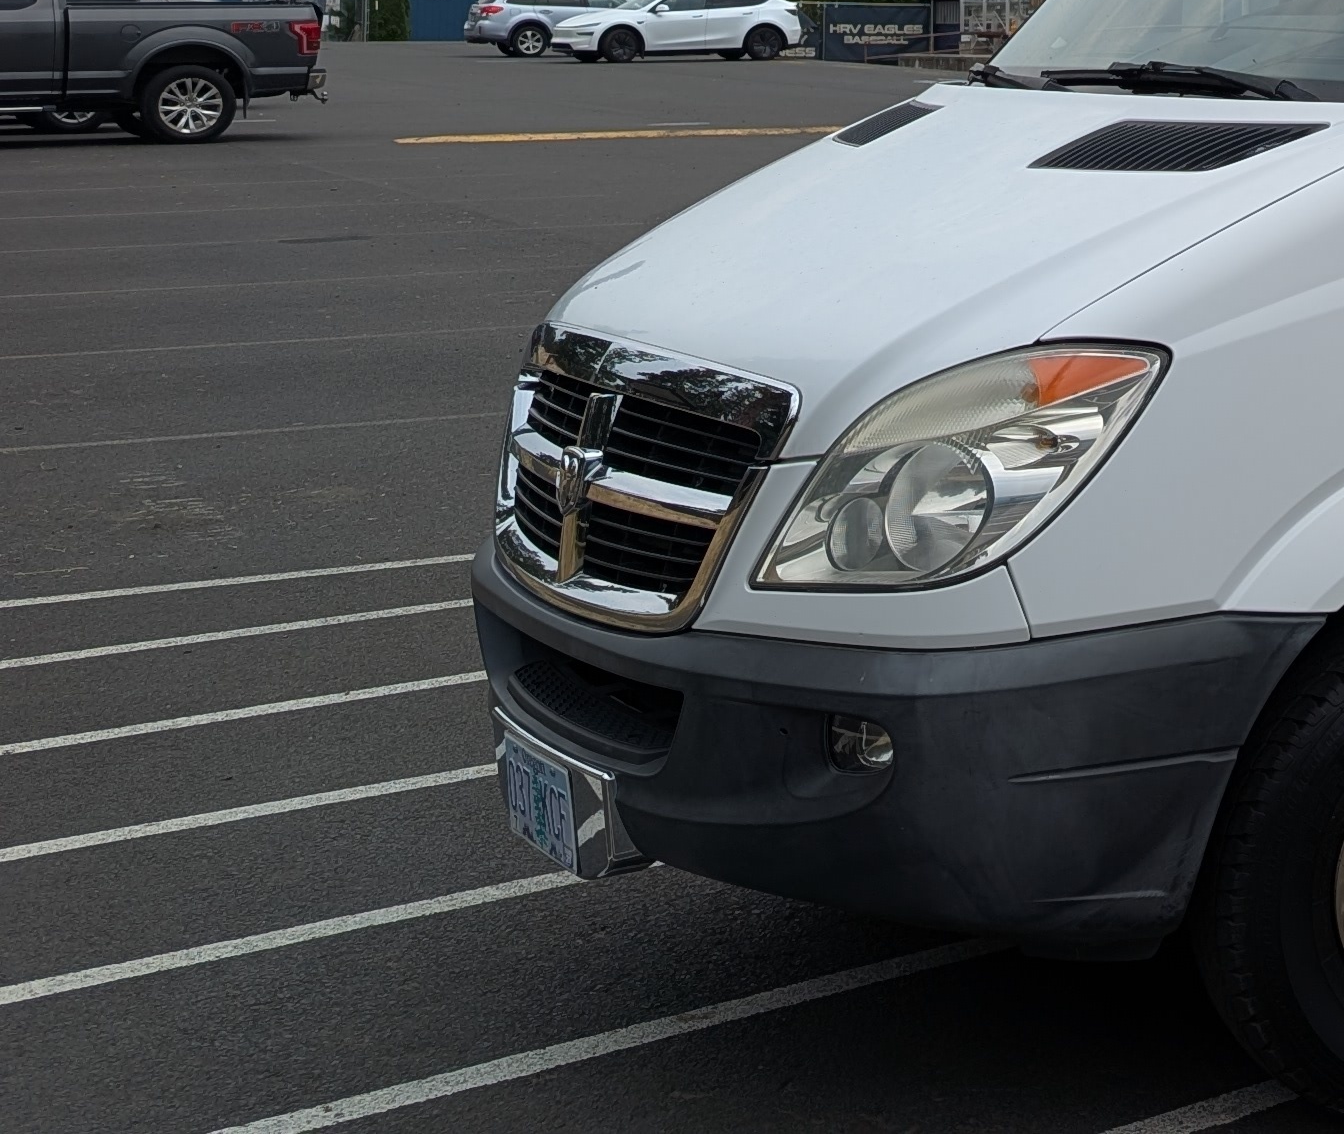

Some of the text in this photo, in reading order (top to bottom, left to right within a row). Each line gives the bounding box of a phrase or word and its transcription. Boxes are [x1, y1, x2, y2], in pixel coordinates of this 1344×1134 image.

[829, 23, 923, 34] HRV EAGLES
[843, 35, 909, 45] BASEBALL
[522, 747, 547, 777] Oregon
